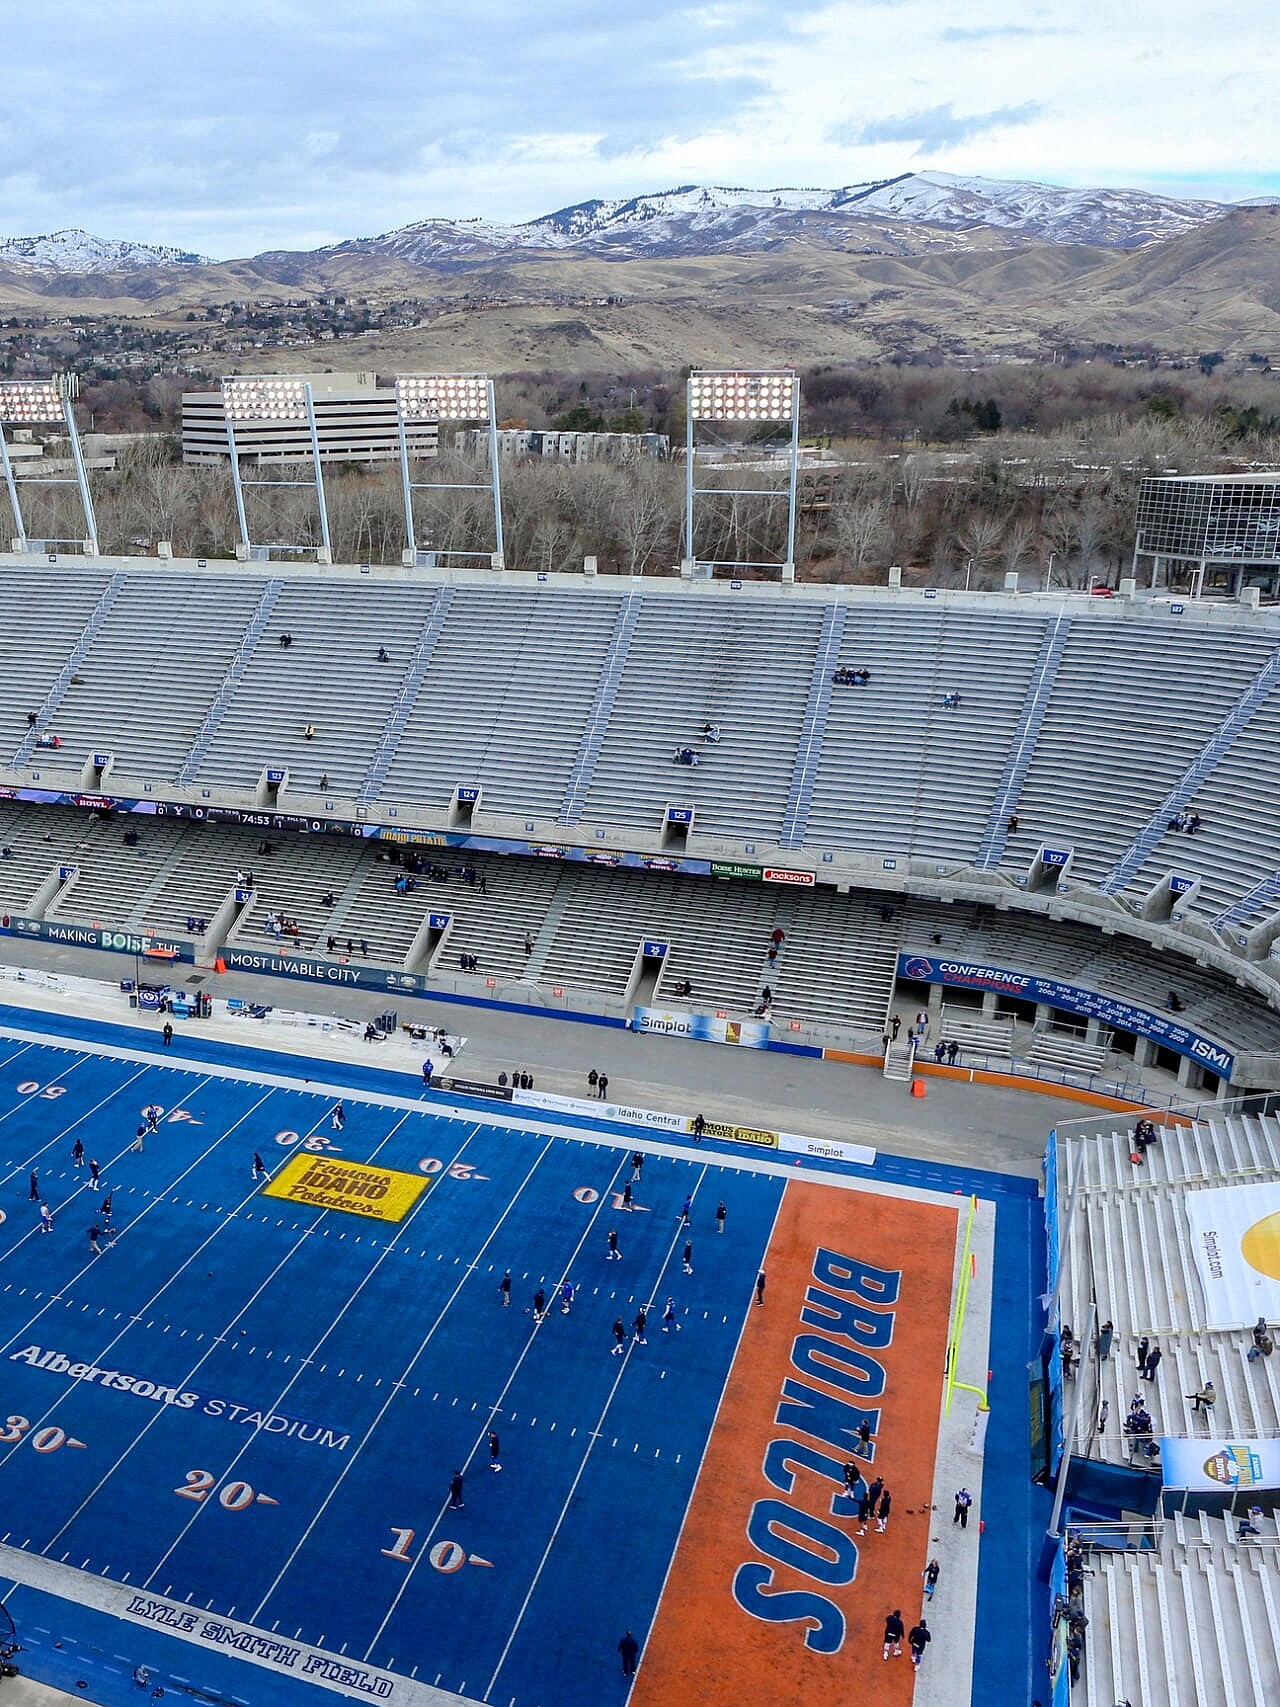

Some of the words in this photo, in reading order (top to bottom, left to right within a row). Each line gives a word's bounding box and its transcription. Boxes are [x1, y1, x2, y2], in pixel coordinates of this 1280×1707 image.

[271, 772, 282, 780] 123
[79, 799, 107, 808] BOWL
[463, 790, 475, 798] 124
[195, 808, 204, 818] 0
[241, 814, 270, 825] 74:53
[674, 811, 686, 819] 125
[312, 821, 321, 831] 0
[1049, 854, 1063, 862] 127
[769, 871, 811, 883] Jacksons
[48, 927, 97, 944] MAKING
[230, 952, 269, 969] MOST
[271, 959, 324, 978] LIVABLE
[327, 967, 361, 983] CITY
[939, 963, 1031, 986] CONFERENCE
[943, 973, 1022, 993] CHAMPIONS
[641, 1016, 692, 1034] Simplot
[1096, 997, 1111, 1006] 1977
[1172, 1026, 1189, 1038] 2000
[1116, 1018, 1132, 1027] 2014
[1136, 1025, 1151, 1035] 2017
[1190, 1038, 1230, 1069] ISMI
[16, 1080, 68, 1100] 50
[618, 1108, 643, 1120] Idaho
[646, 1113, 681, 1126] Central
[690, 1119, 734, 1133] FMOUS
[737, 1130, 772, 1143] IDAHO
[807, 1144, 843, 1158] Simplot
[308, 1158, 391, 1186] Famous
[298, 1171, 389, 1201] IDAHO
[287, 1184, 374, 1214] Potatoes
[1202, 1231, 1223, 1279] Simplot.com
[9, 1344, 200, 1409] Albertsons
[203, 1399, 353, 1451] STADIUM
[732, 1246, 902, 1655] BRONCOS
[1215, 1457, 1226, 1480] BOWL
[173, 1469, 256, 1511] 20
[380, 1527, 467, 1574] 10
[126, 1595, 198, 1633] LYLE
[200, 1620, 300, 1667] SMITH
[302, 1654, 394, 1698] FIELD
